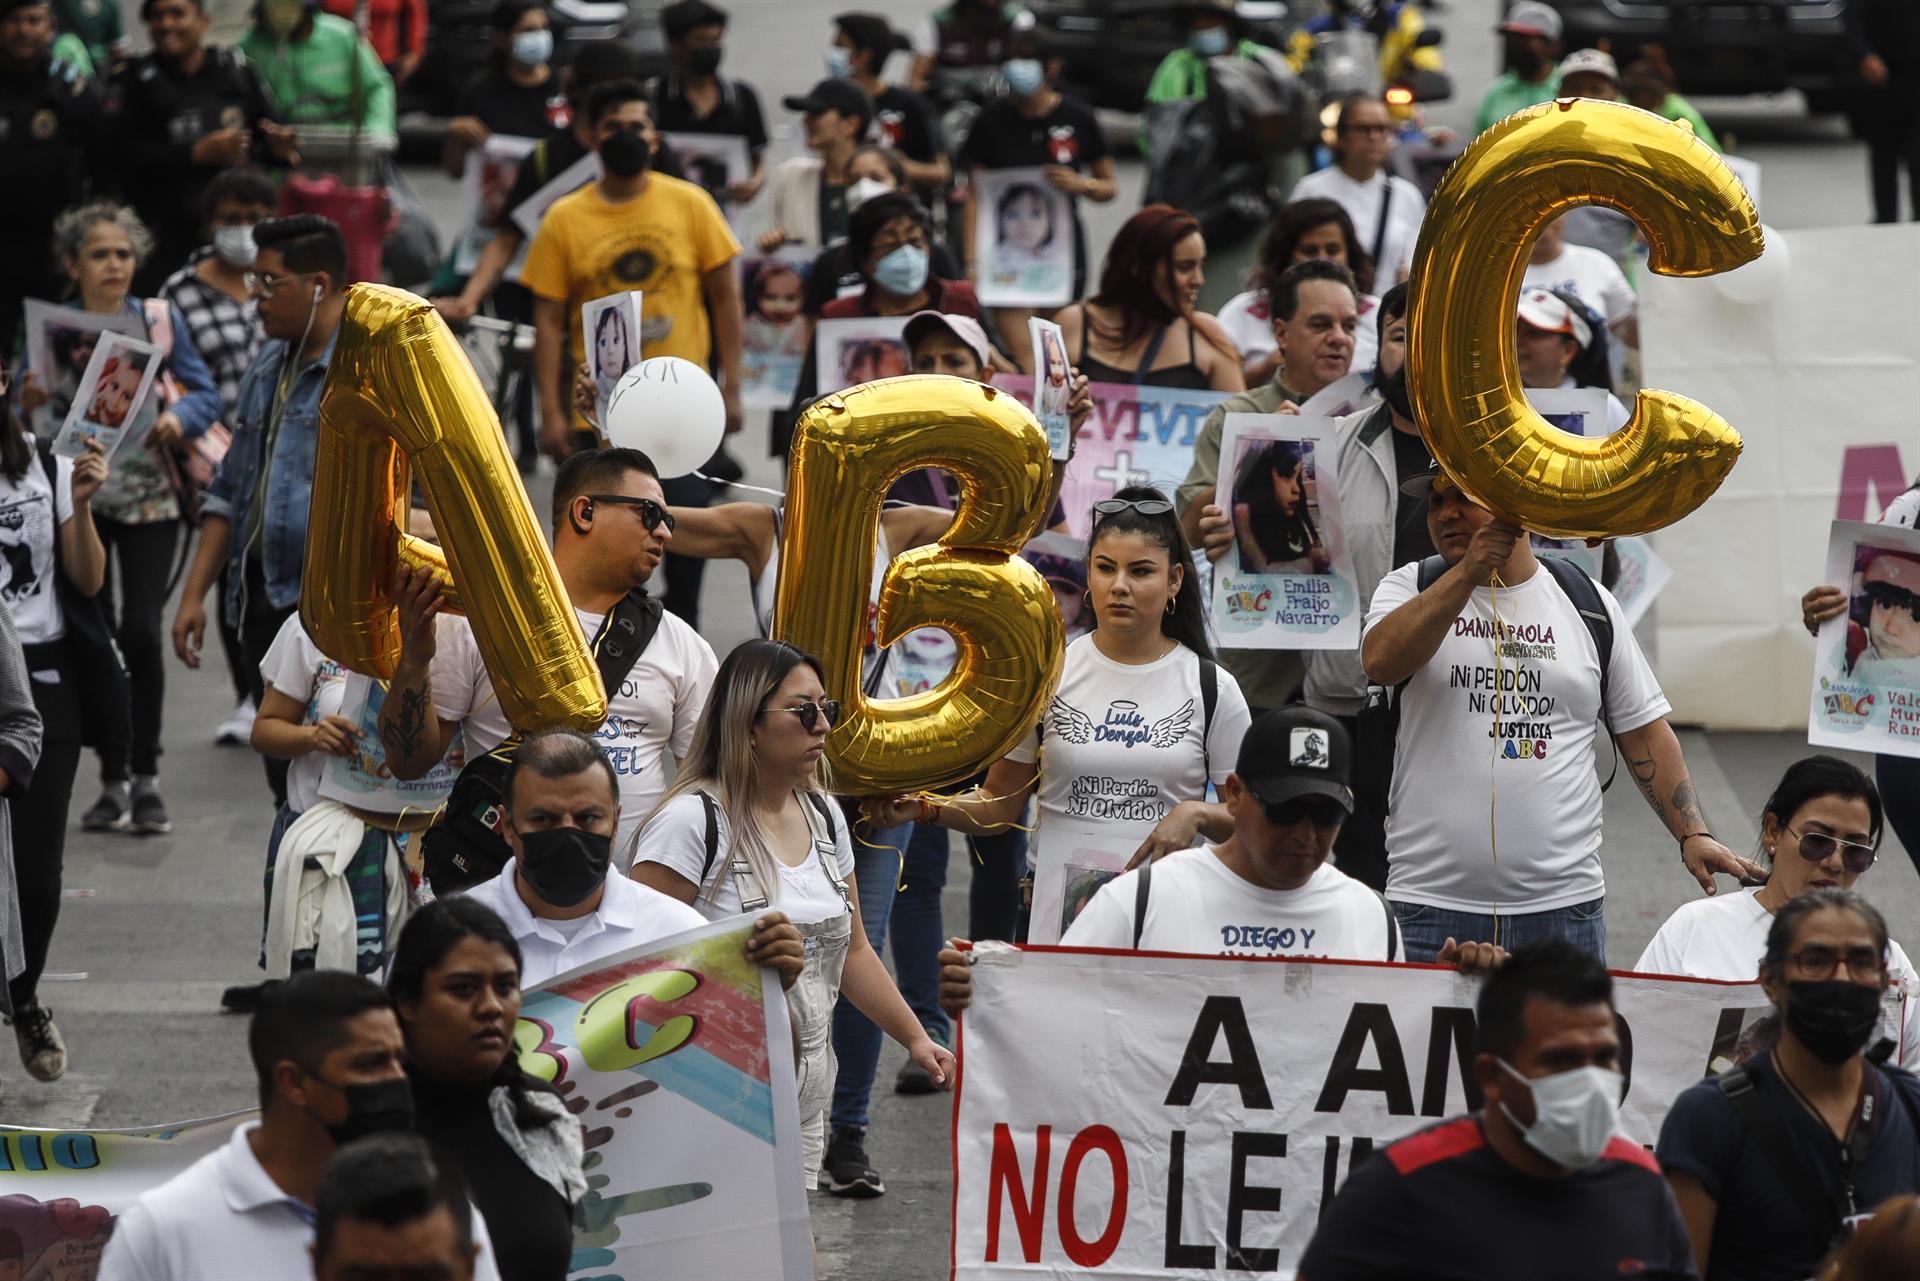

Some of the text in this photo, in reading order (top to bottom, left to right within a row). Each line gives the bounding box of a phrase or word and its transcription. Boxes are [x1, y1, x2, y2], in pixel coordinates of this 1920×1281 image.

[1404, 97, 1765, 541] C
[300, 282, 608, 735] A
[774, 373, 1066, 797] B
[1283, 578, 1332, 594] Emilia
[1286, 594, 1330, 614] Fraijo
[1275, 610, 1340, 626] Navarro
[1454, 616, 1556, 645] DANNA PAOLA
[1474, 664, 1542, 693] PERDÓN
[1469, 692, 1555, 717] Ni OLVIDO!
[1094, 724, 1153, 749] Denzel
[1488, 721, 1553, 740] JUSTICIA
[1500, 739, 1547, 760] ABC
[1100, 777, 1158, 798] Perdón
[1065, 795, 1089, 816] Ni
[1220, 925, 1316, 951] DIEGO Y
[1163, 995, 1274, 1110] A
[984, 1122, 1128, 1268] NO
[1164, 1129, 1288, 1272] LE
